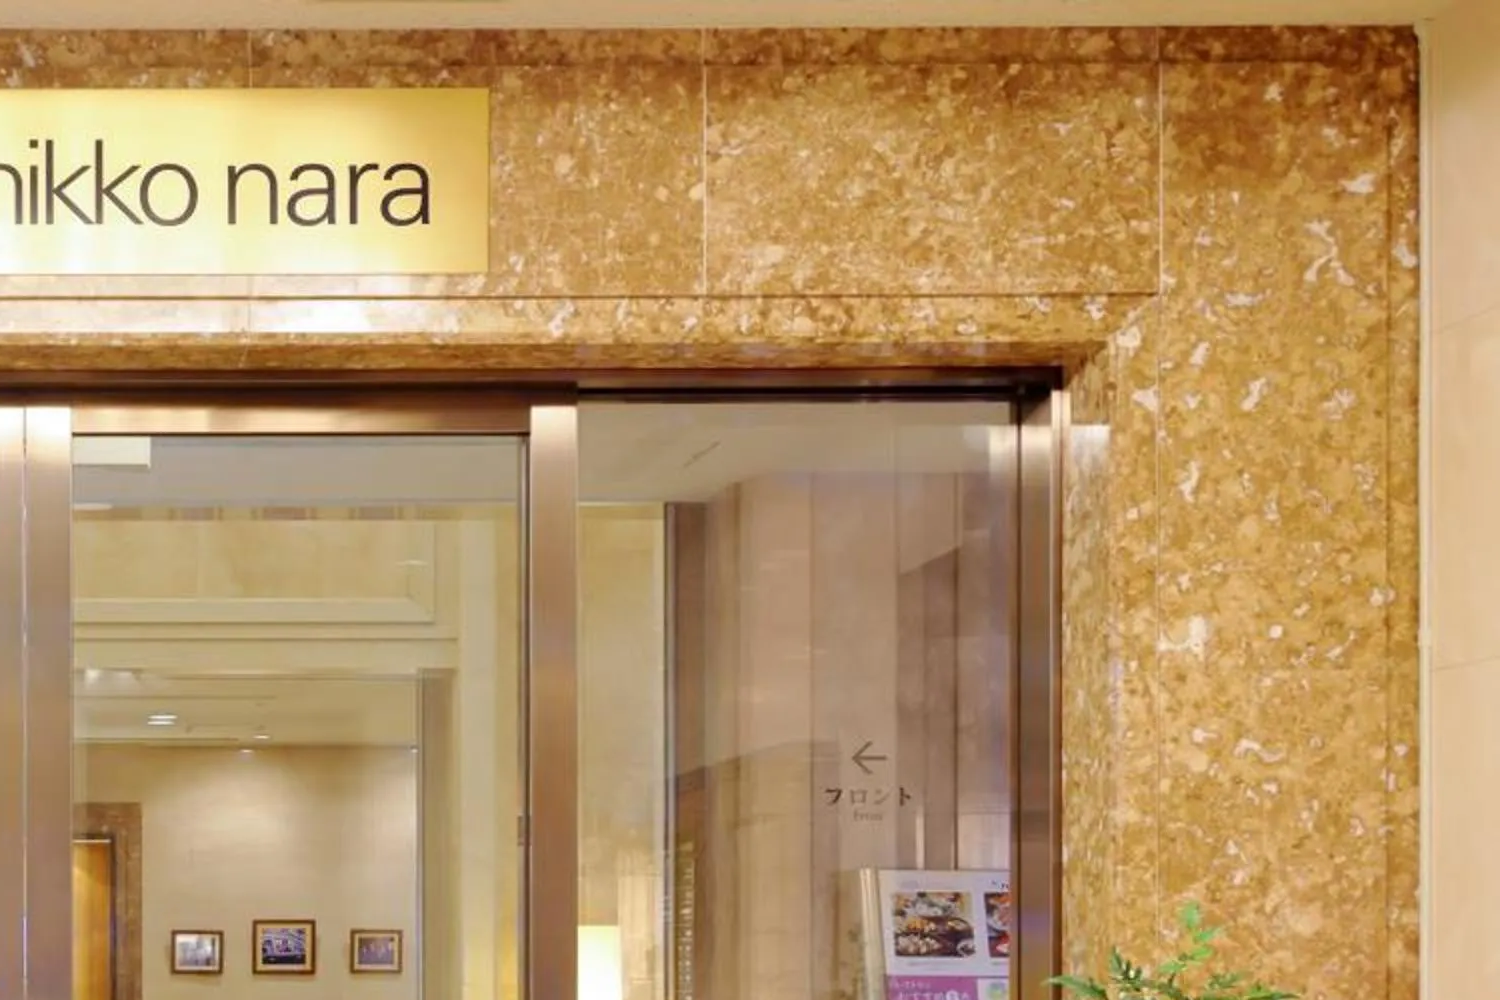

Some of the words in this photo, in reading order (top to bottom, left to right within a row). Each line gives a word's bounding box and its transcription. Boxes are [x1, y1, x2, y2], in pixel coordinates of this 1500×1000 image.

[227, 163, 430, 226] nara
[825, 786, 911, 807] フロント
